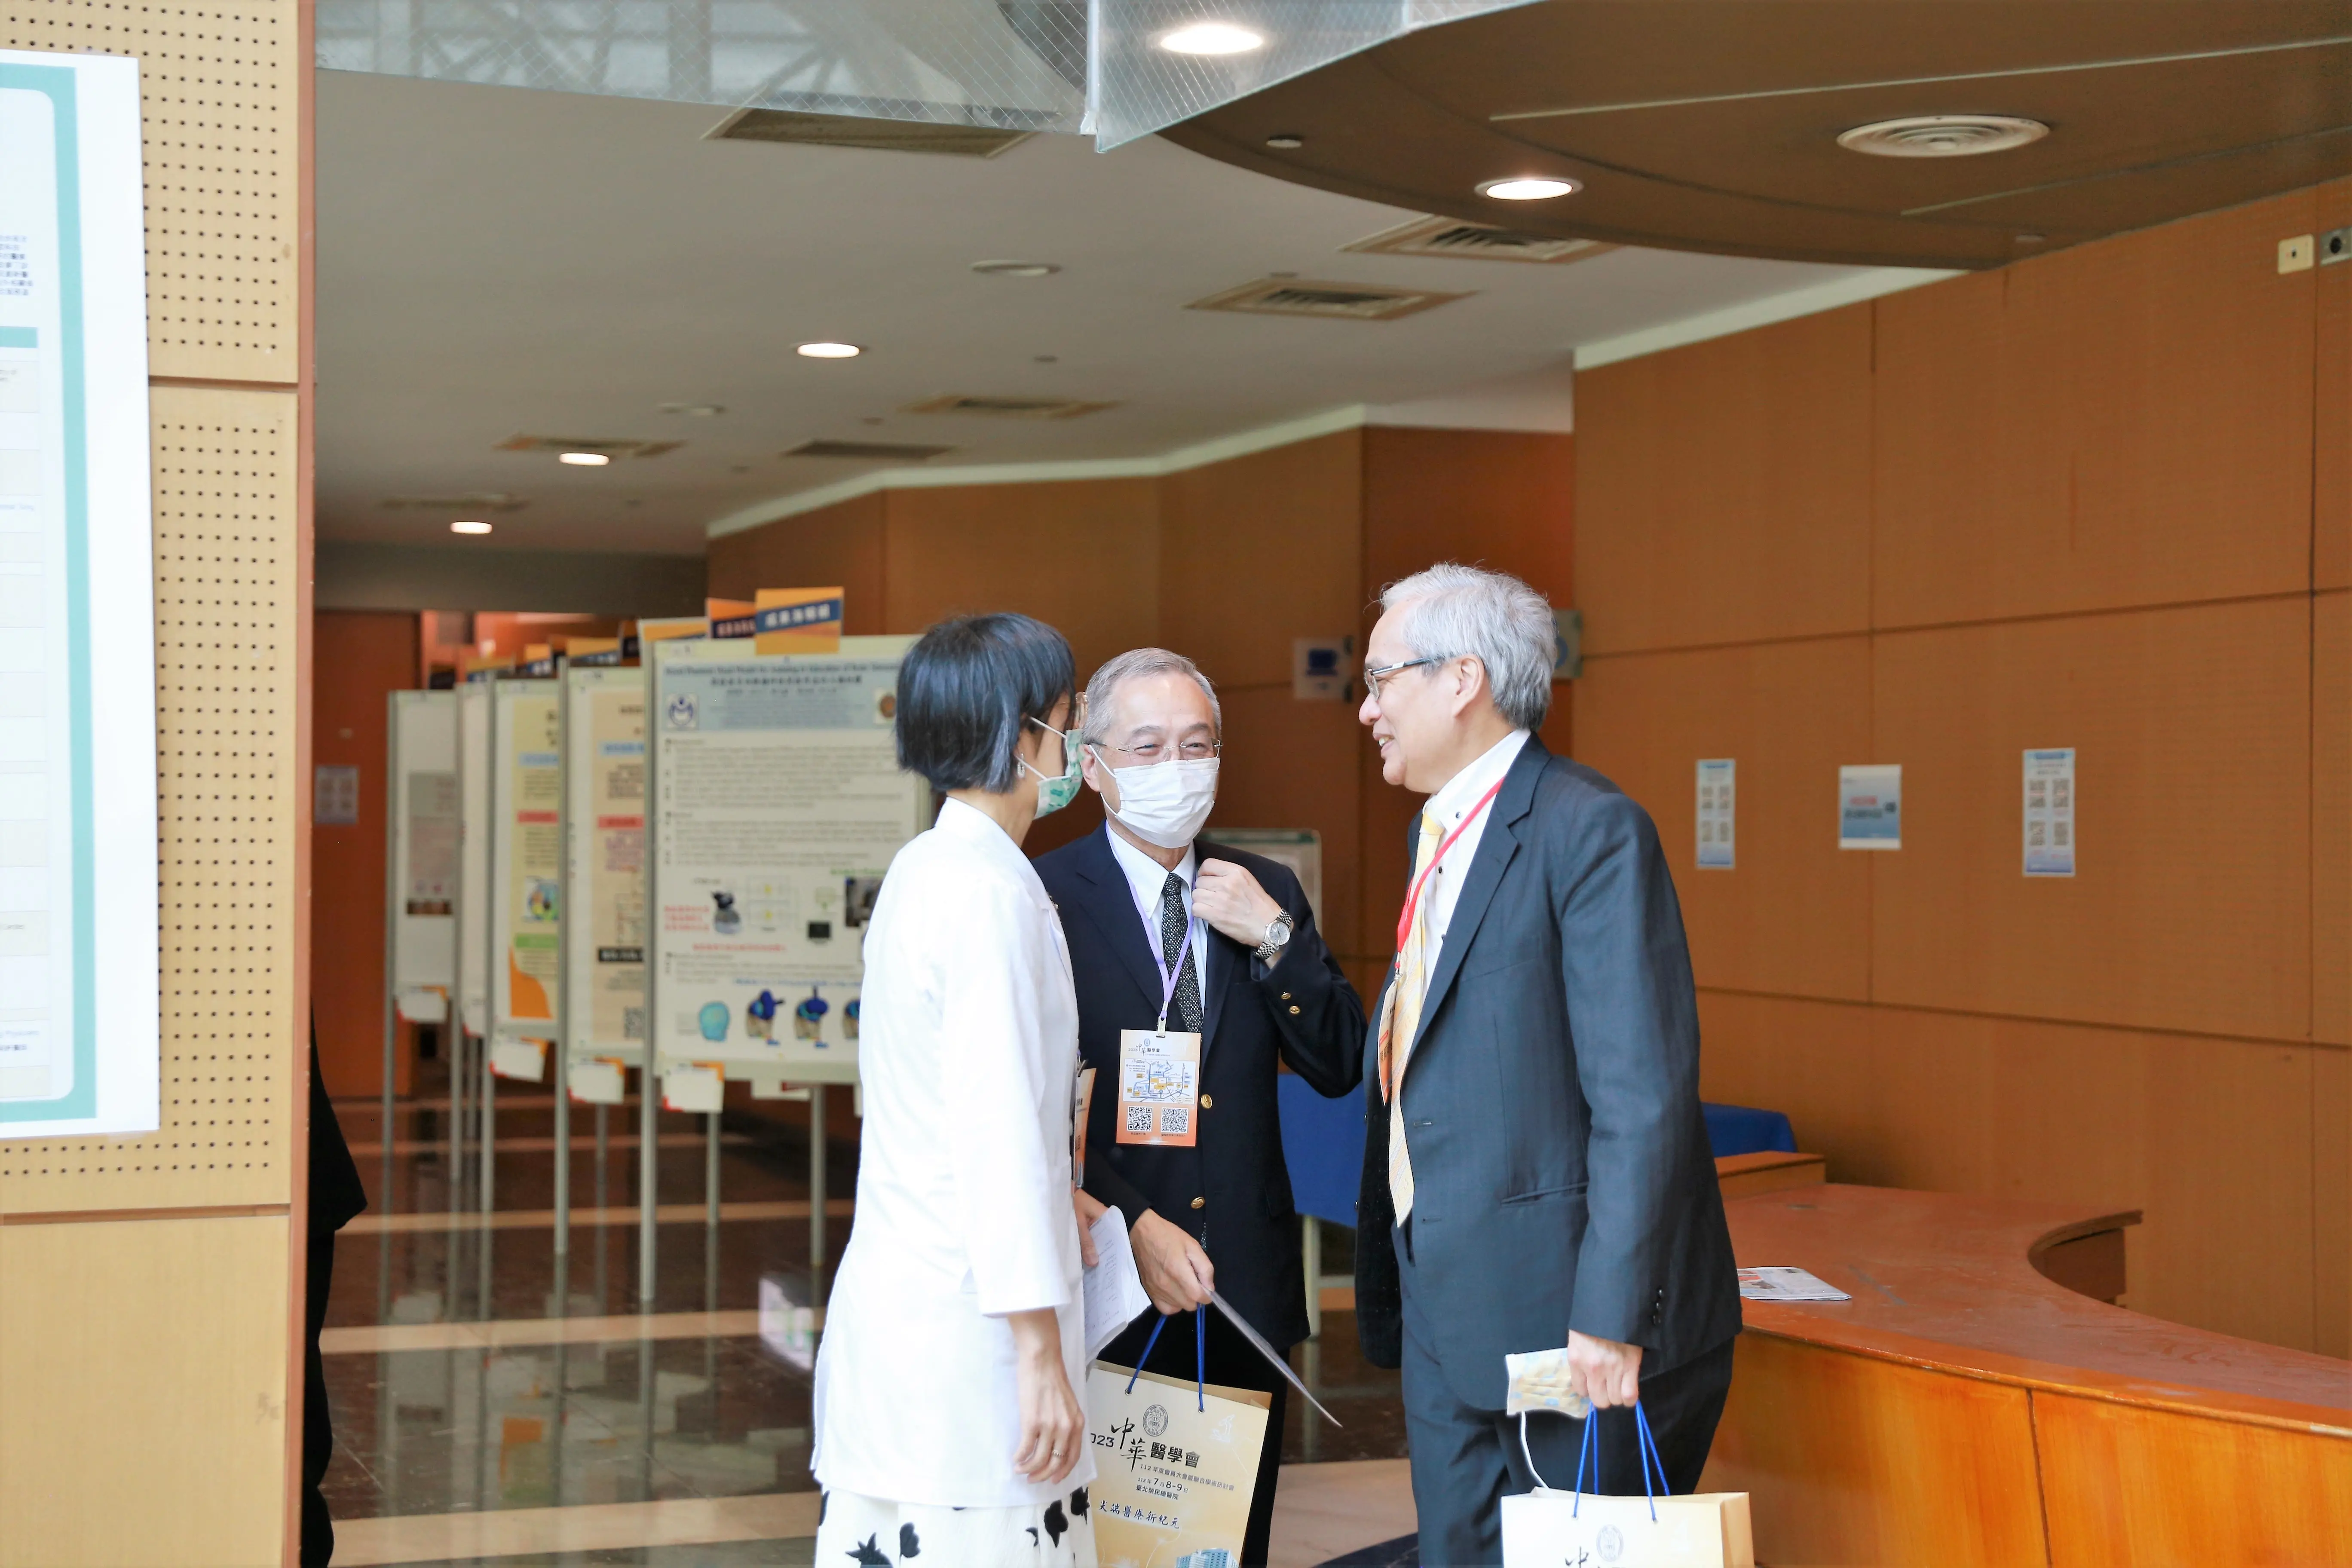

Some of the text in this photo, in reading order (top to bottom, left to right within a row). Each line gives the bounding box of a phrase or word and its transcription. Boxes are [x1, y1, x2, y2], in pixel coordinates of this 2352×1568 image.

[1136, 1484, 1179, 1501] 臺北榮民總醫院
[1165, 1481, 1182, 1491] 8-9
[1099, 1500, 1180, 1529] 尖端醫療新紀元
